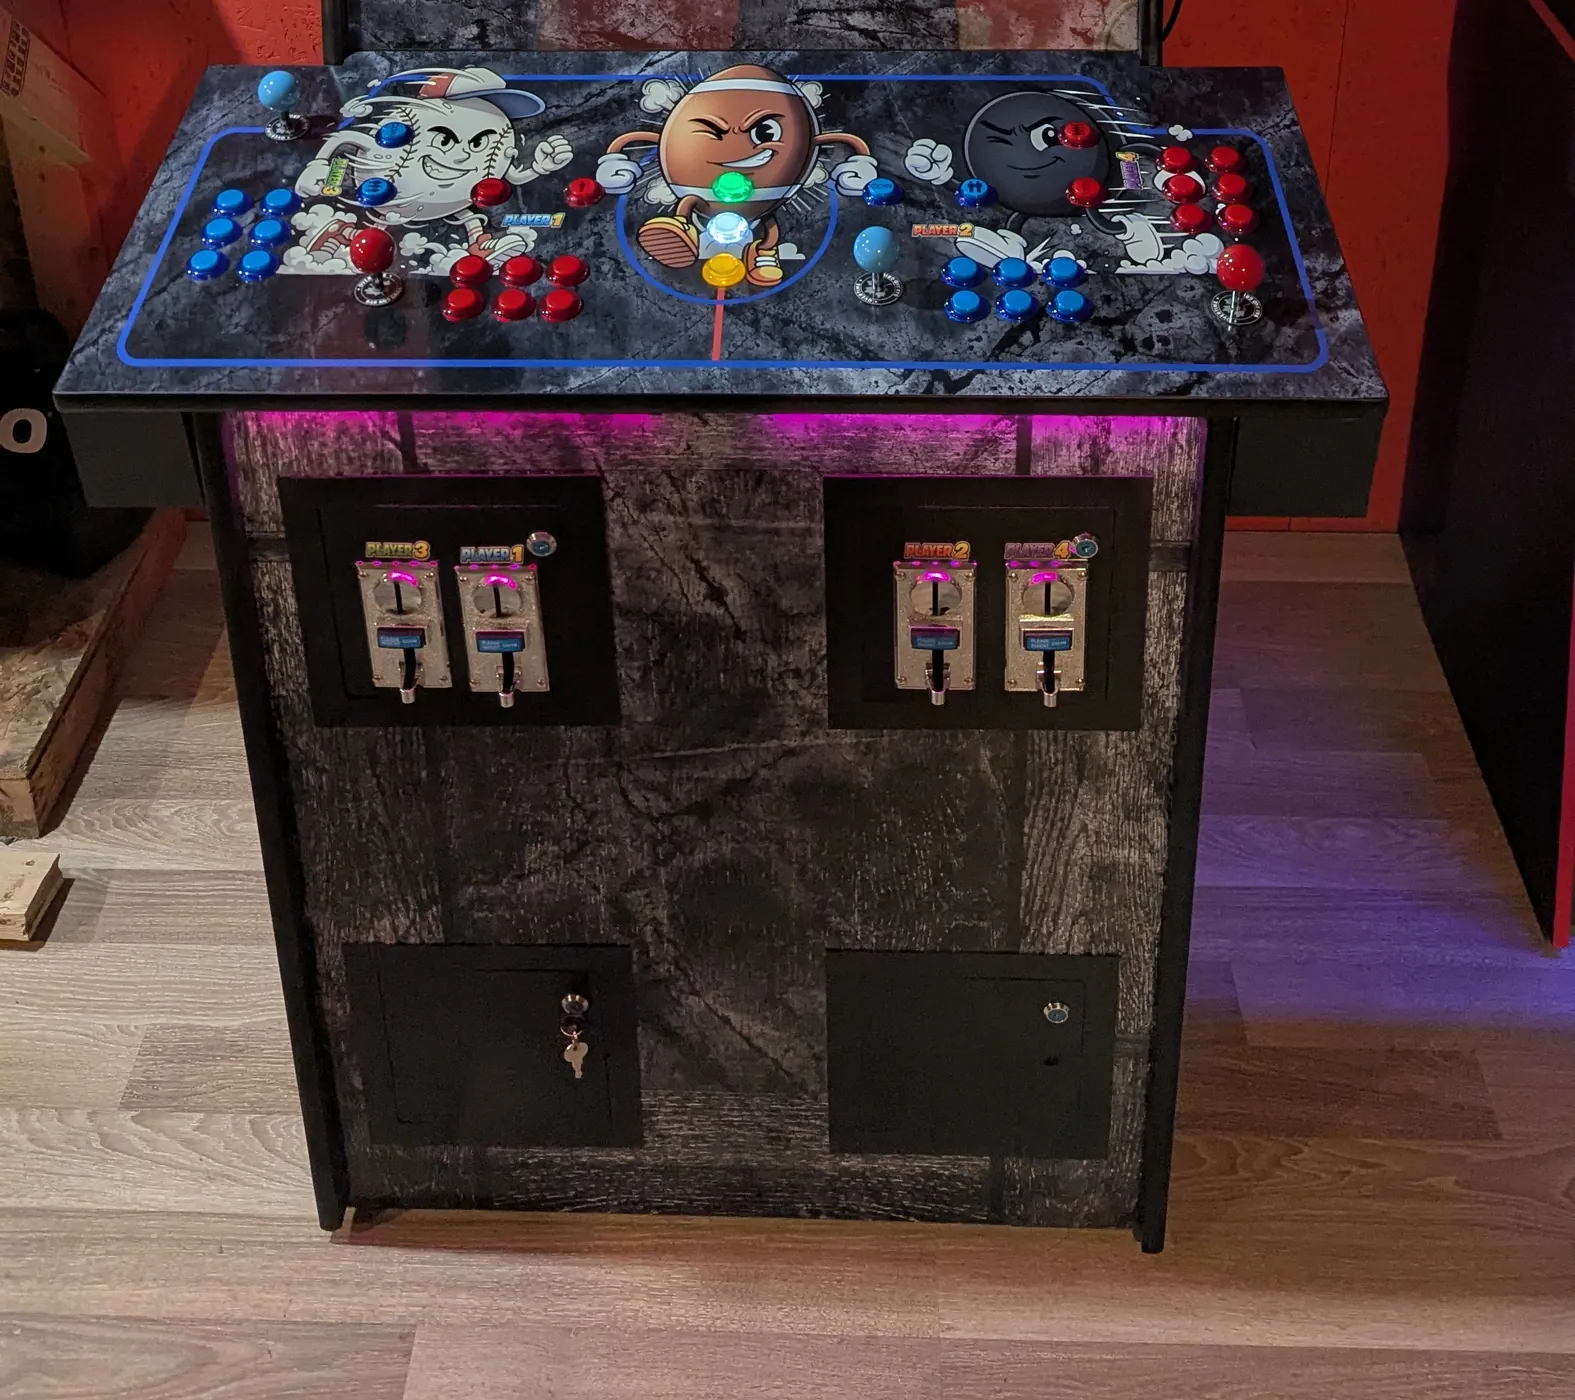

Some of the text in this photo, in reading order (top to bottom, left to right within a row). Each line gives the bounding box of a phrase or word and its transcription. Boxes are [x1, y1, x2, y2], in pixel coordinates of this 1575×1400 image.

[502, 212, 566, 228] PLAYER 1
[912, 222, 974, 237] PLAYER 2
[366, 540, 431, 560] PLAYER 3
[460, 544, 525, 564] PLAYER 1
[904, 540, 971, 560] PLAYER 2
[1005, 540, 1072, 560] PLAYER 4
